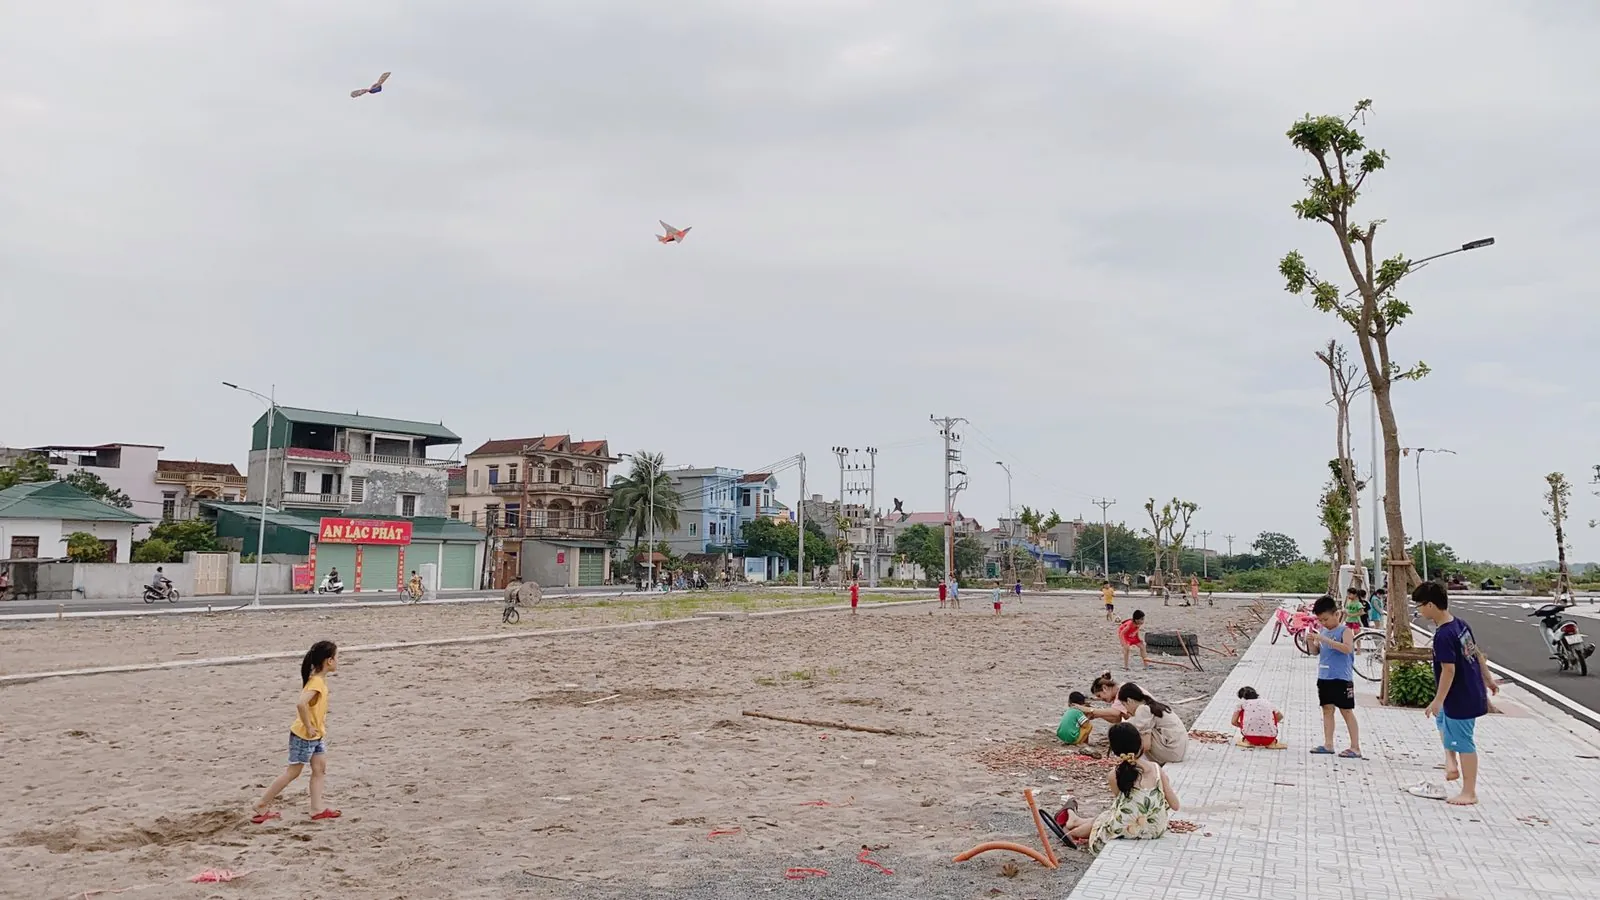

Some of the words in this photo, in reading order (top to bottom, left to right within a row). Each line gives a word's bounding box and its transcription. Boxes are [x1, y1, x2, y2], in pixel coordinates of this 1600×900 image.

[322, 524, 343, 538] AN
[345, 525, 370, 541] LẠC
[371, 525, 404, 540] PHÁT
